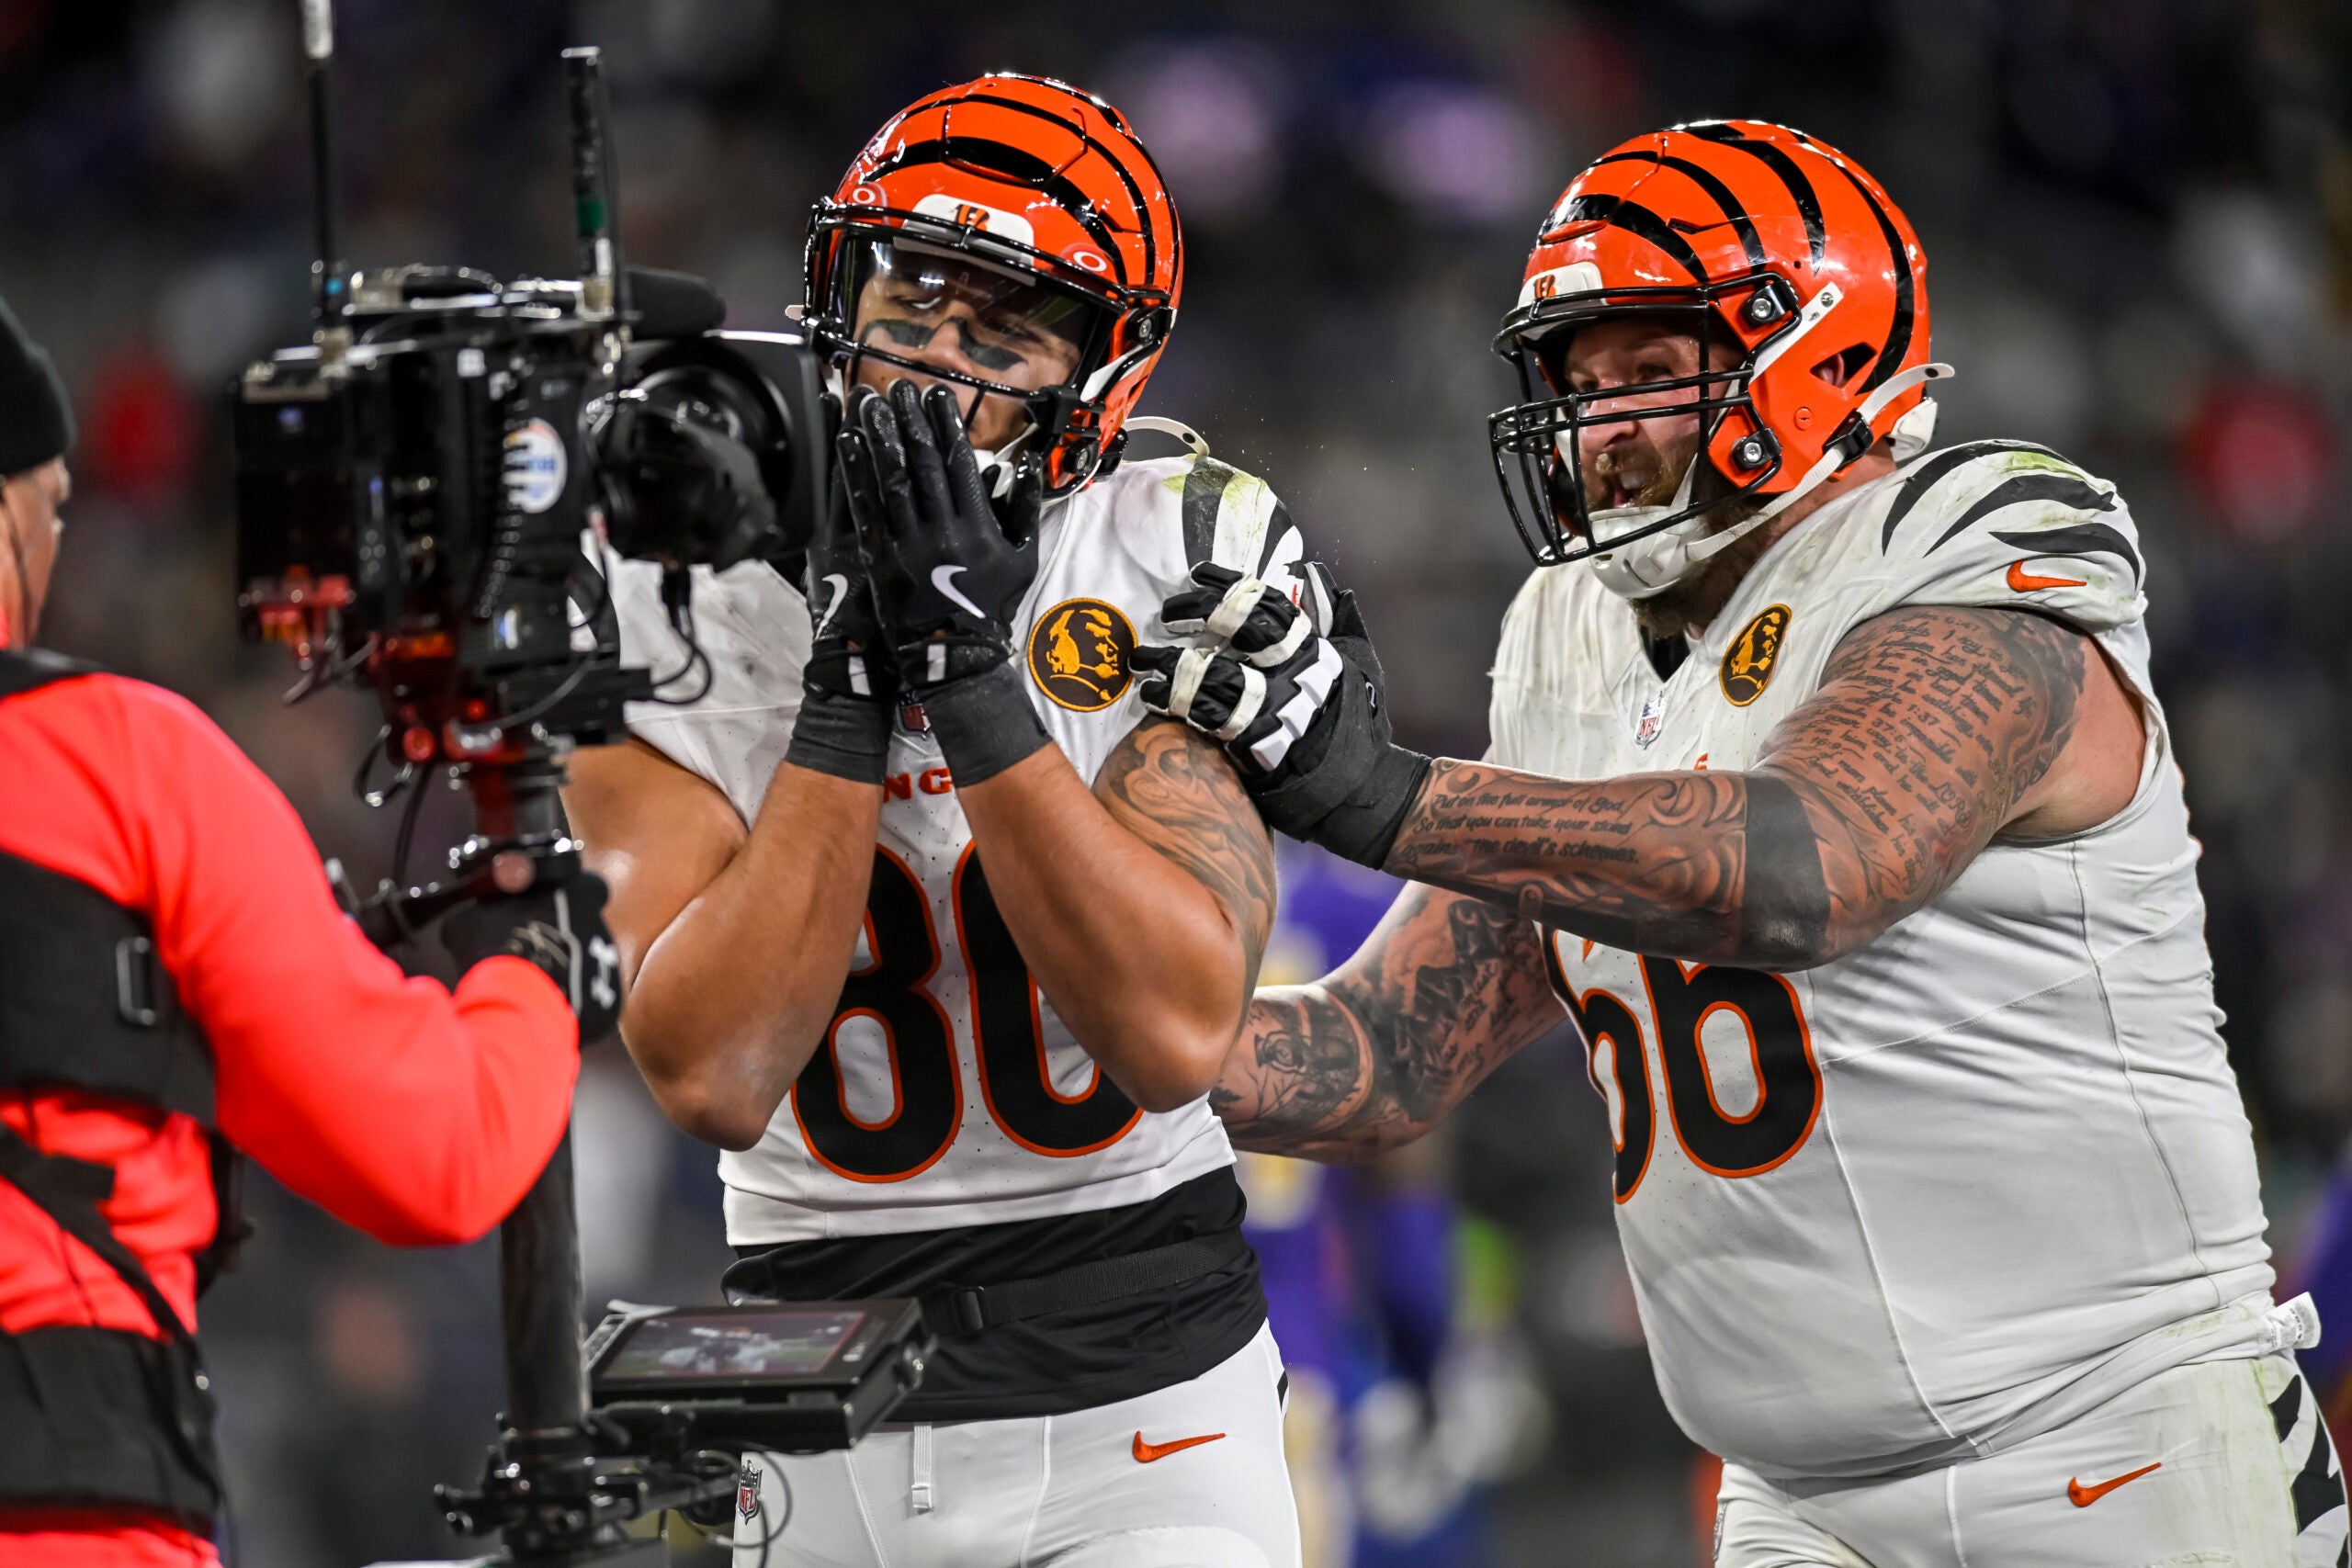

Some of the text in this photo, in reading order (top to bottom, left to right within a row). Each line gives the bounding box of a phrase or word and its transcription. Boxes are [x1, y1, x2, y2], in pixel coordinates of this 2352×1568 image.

[1432, 793, 1460, 809] Put
[1457, 795, 1476, 807] on
[1476, 792, 1500, 806] the
[1498, 792, 1527, 810] full
[1572, 795, 1591, 813] of
[1436, 813, 1468, 831] that
[1466, 816, 1493, 832] you
[1494, 816, 1521, 829] can
[1521, 815, 1552, 829] take
[1554, 818, 1589, 833] your
[1589, 819, 1633, 835] stand
